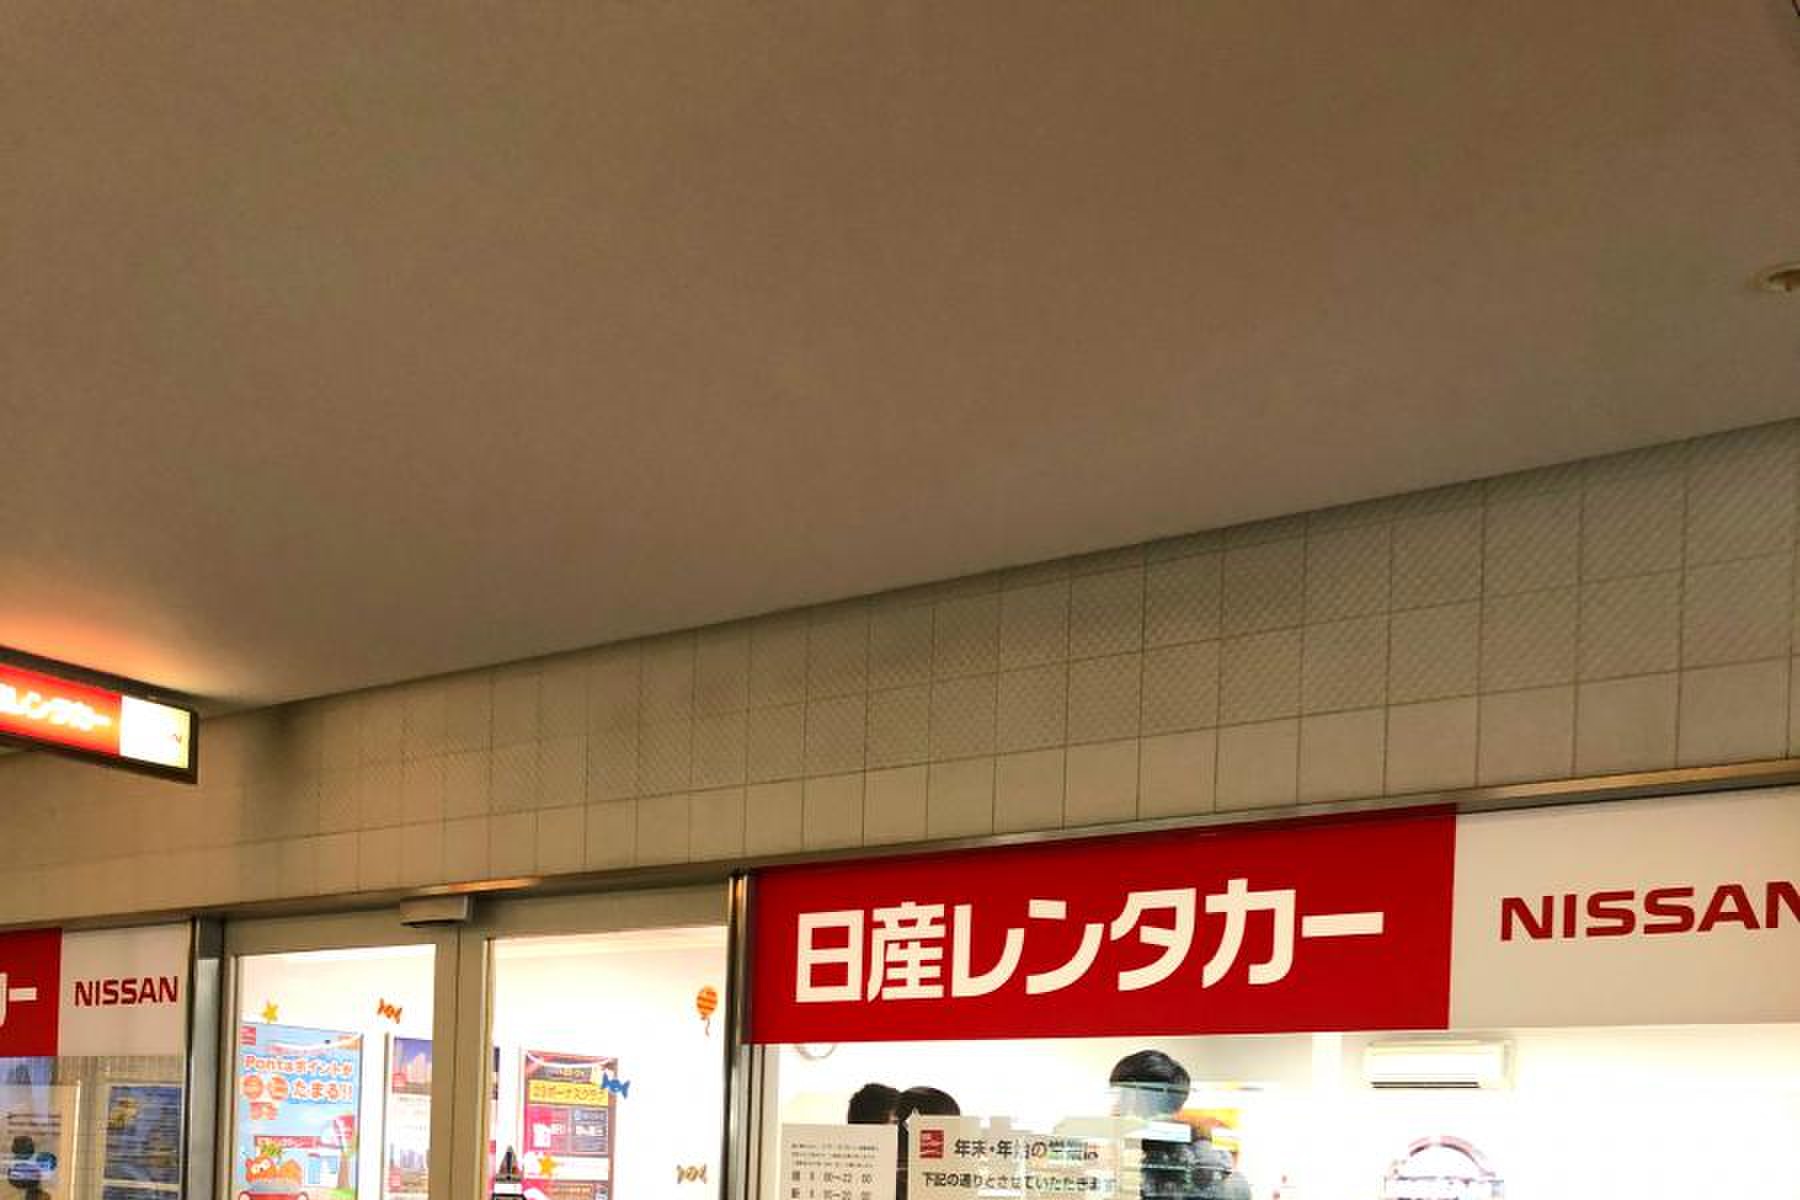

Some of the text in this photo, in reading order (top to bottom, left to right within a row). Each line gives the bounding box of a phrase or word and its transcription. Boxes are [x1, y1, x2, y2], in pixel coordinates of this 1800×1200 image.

[795, 877, 1385, 1003] 日産レンタカー
[1500, 881, 1800, 942] NISSAN
[74, 976, 179, 1007] NISSAN
